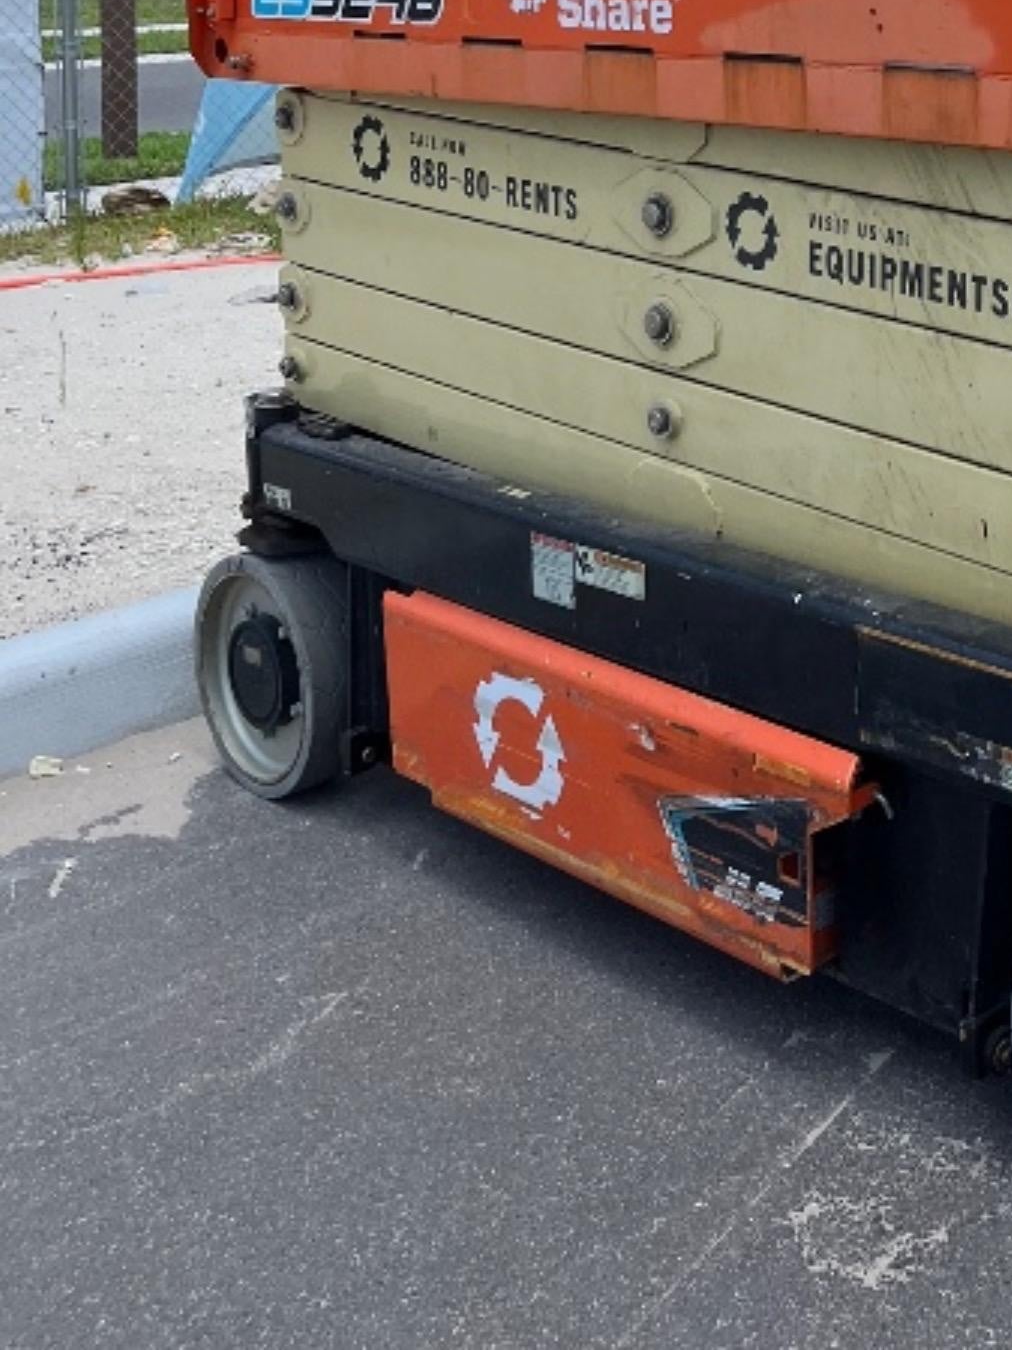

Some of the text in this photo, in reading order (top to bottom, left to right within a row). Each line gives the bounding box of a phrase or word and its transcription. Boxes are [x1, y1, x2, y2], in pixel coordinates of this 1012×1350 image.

[410, 155, 578, 220] 888-80-RENTS
[809, 212, 849, 235] VISIT
[857, 221, 877, 241] US
